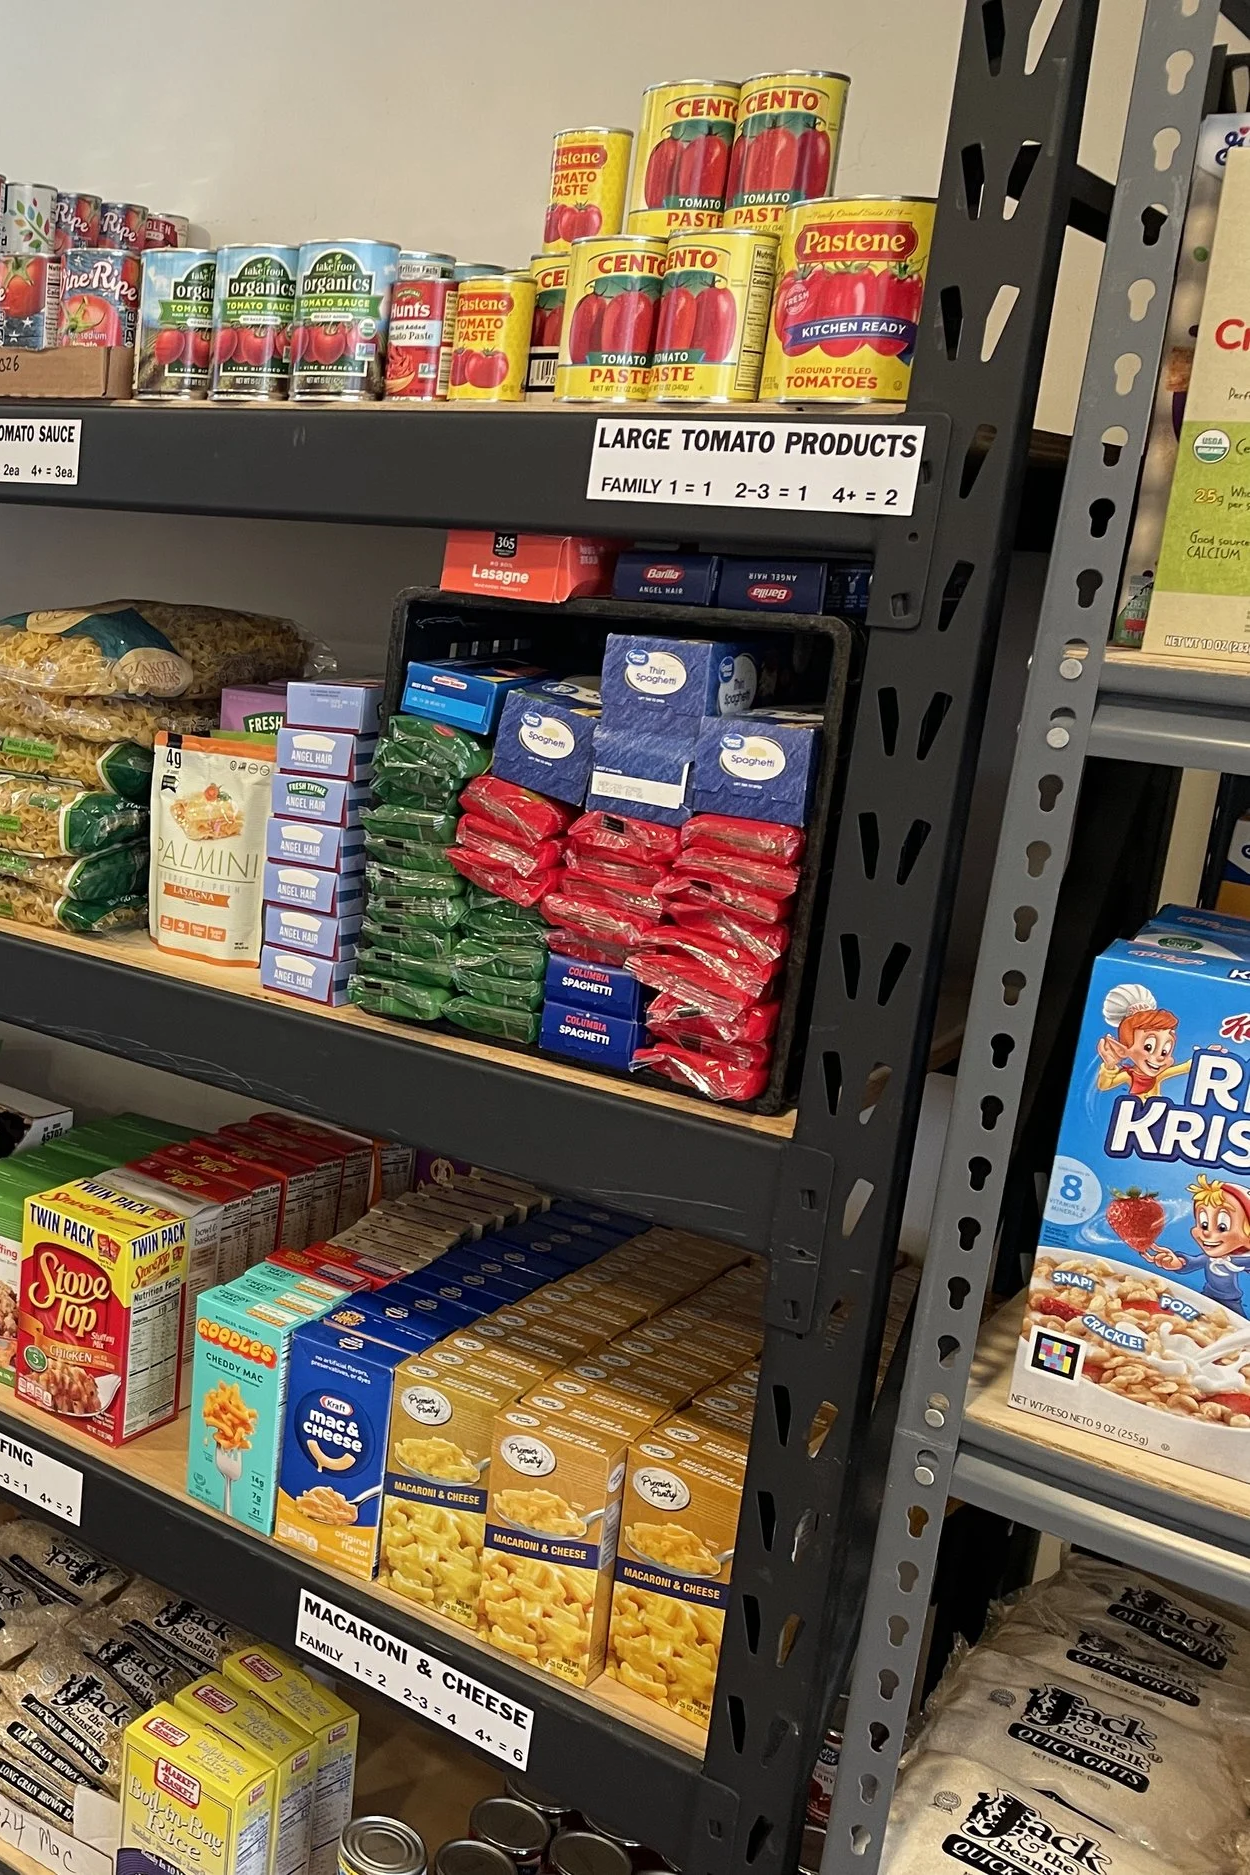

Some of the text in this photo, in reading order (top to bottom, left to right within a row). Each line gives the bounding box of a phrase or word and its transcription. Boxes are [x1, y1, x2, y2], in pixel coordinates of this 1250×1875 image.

[746, 90, 819, 113] CENTO
[678, 198, 722, 210] TOMATO
[743, 192, 790, 205] TOMATO
[666, 211, 724, 228] PASTE
[803, 229, 906, 255] Pastene
[315, 262, 356, 272] take root
[92, 262, 138, 301] Ripe
[303, 275, 370, 295] organics
[300, 299, 370, 308] TOMATO SAUCE
[457, 293, 509, 313] Pastene
[456, 318, 504, 330] TOMATO
[801, 320, 908, 338] KITCHEN READY
[458, 330, 495, 342] PASTE
[794, 367, 872, 376] GROUND PEELED
[786, 375, 878, 390] TOMATOES
[38, 425, 76, 443] SAUCE
[598, 427, 918, 458] LARGE TOMATO PRODUCTS
[1201, 437, 1224, 446] USDA
[3, 464, 20, 476] 2ea
[31, 464, 42, 477] 4+
[55, 465, 76, 479] 3ea.
[601, 477, 898, 506] FAMILY 1 = 1 2-3 = 1 4+ = 2
[1193, 487, 1225, 506] 25g
[495, 536, 516, 550] 365
[1186, 546, 1241, 561] CALCIUM
[471, 564, 530, 585] Lasagne
[647, 568, 682, 580] Barilla
[639, 586, 683, 596] ANGEL HAIR
[635, 673, 678, 687] Spaghetti
[649, 666, 667, 676] Thin
[528, 730, 567, 749] Spaghetti
[166, 748, 182, 768] 4g
[730, 753, 776, 769] Spaghetti
[288, 781, 328, 797] FRESH THYME
[285, 796, 326, 812] ANGEL HAIR
[172, 885, 215, 903] LASAGNA
[568, 966, 610, 984] COLUMBIA
[561, 976, 613, 997] SPAGHETTI
[30, 1203, 95, 1249] TWIN PACK
[29, 1252, 110, 1309] Stove
[1052, 1271, 1093, 1291] SNAP!
[53, 1297, 97, 1337] Top
[1160, 1296, 1199, 1321] POP!
[197, 1316, 276, 1366] GOODLES
[1082, 1314, 1144, 1350] CRACKLE!
[50, 1343, 93, 1364] CHICKEN
[205, 1351, 264, 1384] CHEDDY MAC
[326, 1399, 347, 1413] Kraft
[309, 1409, 360, 1439] mac &
[1010, 1393, 1150, 1447] NET WT/PESO NETO 9 OZ (255g)
[39, 1492, 52, 1504] 4+
[66, 1505, 73, 1517] 2
[492, 1533, 587, 1560] MACARONI & CHEESE
[304, 1596, 528, 1730] MACARONI & CHEESE
[299, 1631, 523, 1762] FAMILY 1 = 2 2-3 = 4 4+ = 6
[1021, 1684, 1157, 1751] Jack
[1016, 1728, 1143, 1785] QUICK GRITS
[161, 1763, 197, 1790] MARKET
[162, 1772, 195, 1800] BASKET
[145, 1809, 201, 1862] Rice
